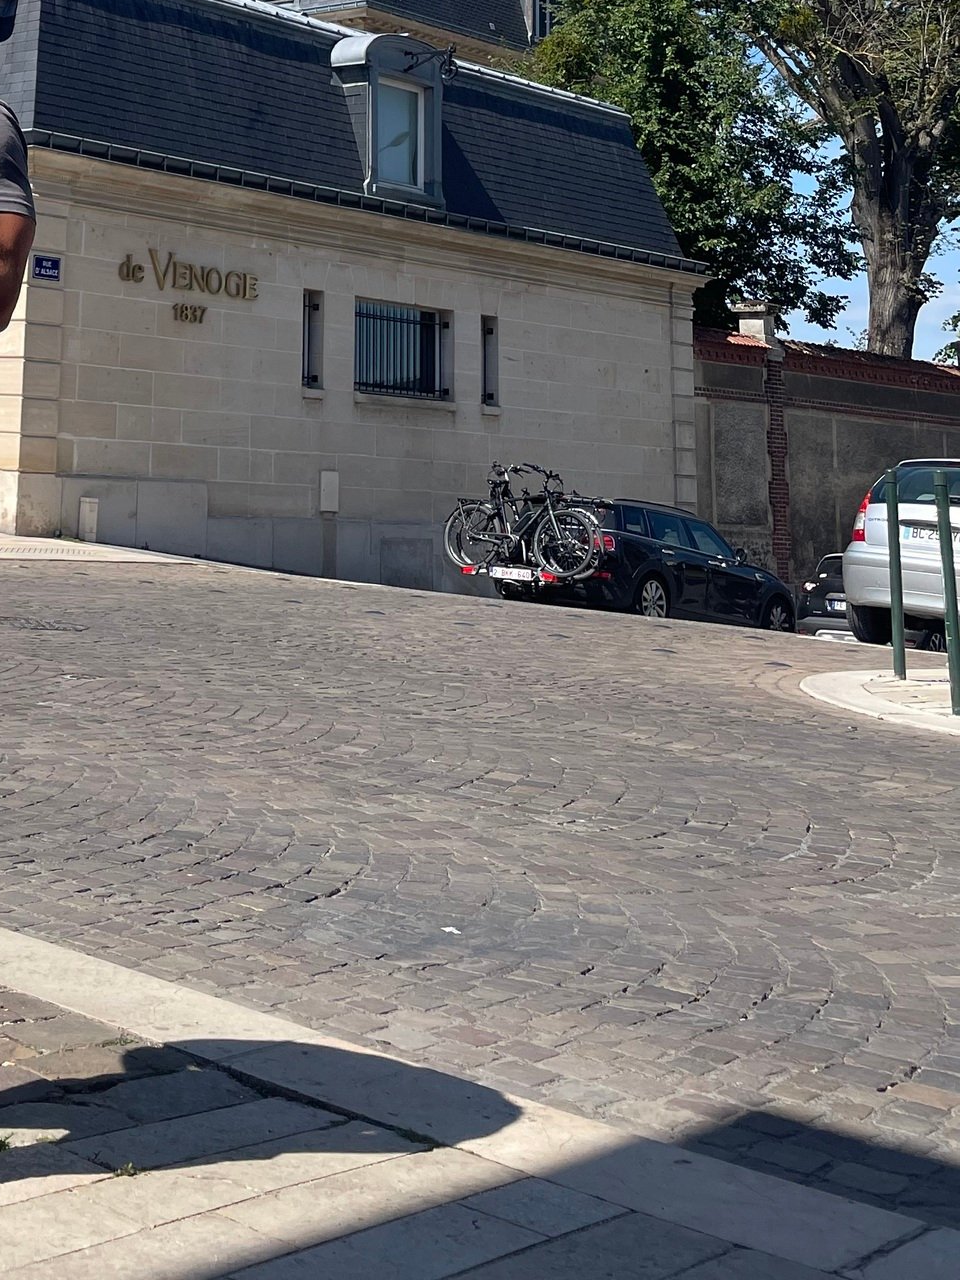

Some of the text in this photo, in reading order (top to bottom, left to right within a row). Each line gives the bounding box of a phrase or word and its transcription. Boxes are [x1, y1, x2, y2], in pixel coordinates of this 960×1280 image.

[118, 248, 259, 300] de VENOGE
[172, 303, 208, 324] 1837
